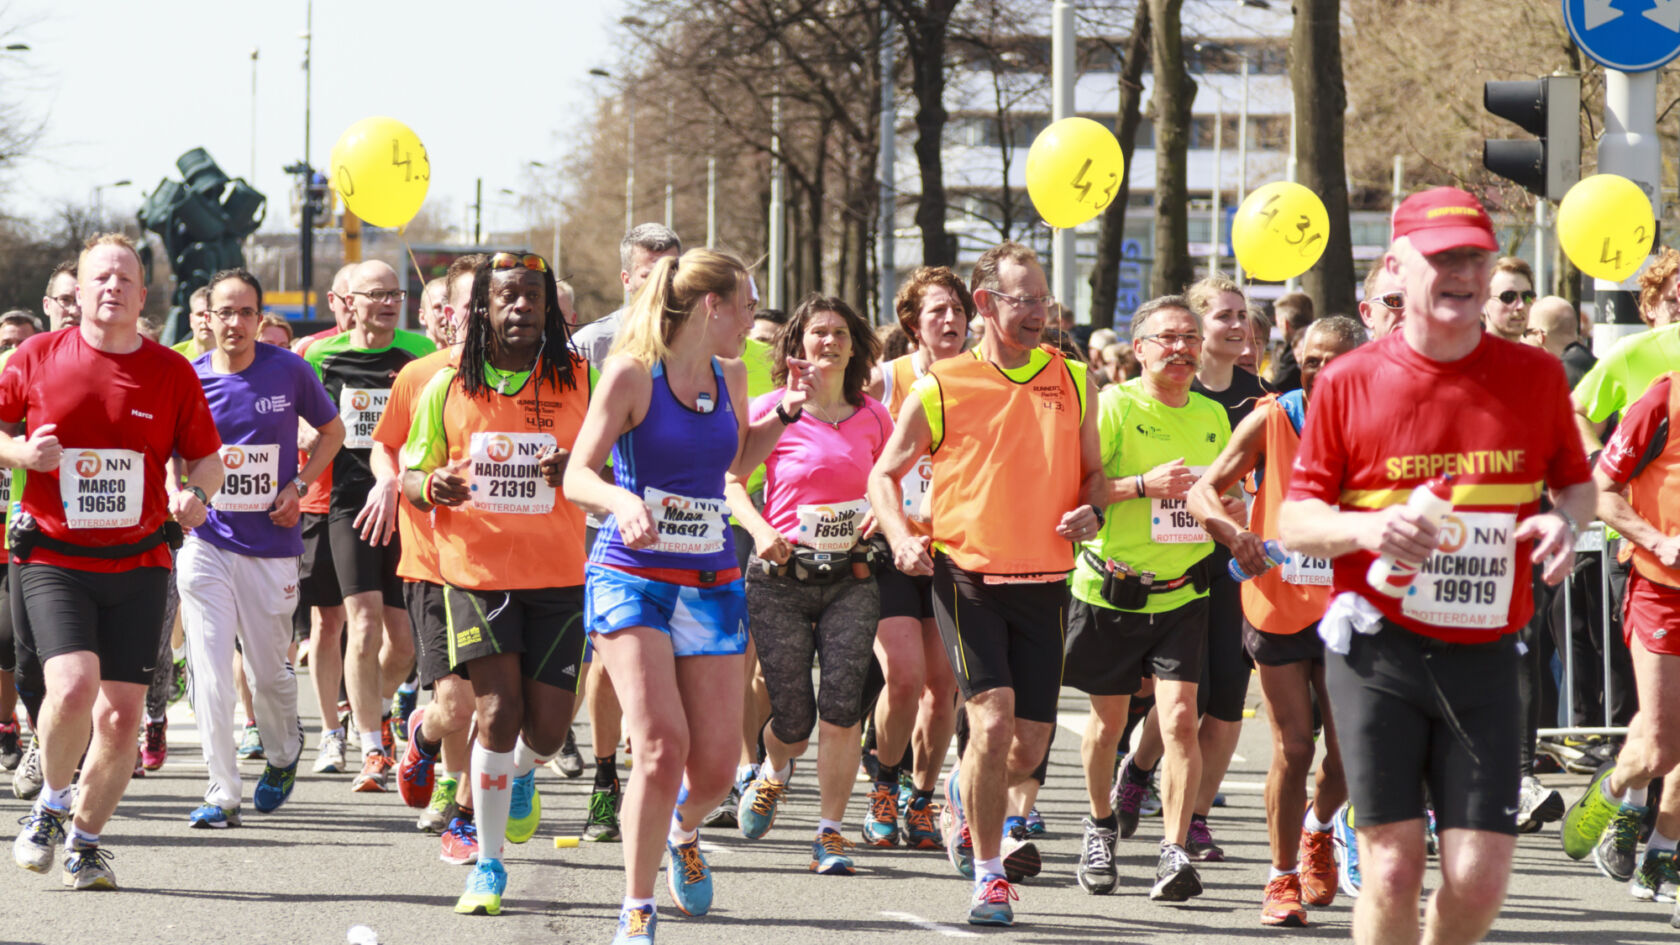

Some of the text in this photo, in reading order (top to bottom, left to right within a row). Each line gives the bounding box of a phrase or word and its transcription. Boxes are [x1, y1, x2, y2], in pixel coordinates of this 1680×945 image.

[131, 409, 153, 420] Marco
[518, 443, 543, 456] NN
[106, 458, 131, 471] NN
[248, 452, 269, 463] NN
[475, 463, 544, 479] HAROLDIN
[1386, 450, 1525, 480] SERPENTINE
[79, 479, 126, 493] MARCO
[489, 480, 537, 499] 21319
[77, 495, 126, 513] 19658
[695, 501, 719, 513] NN
[69, 518, 118, 527] OTTERDAM
[1170, 510, 1199, 528] 165
[814, 520, 854, 538] F8569
[1474, 527, 1508, 545] NN
[1156, 533, 1203, 542] ROTTERDAM
[648, 541, 702, 553] OTTERDAM
[1421, 554, 1508, 577] NICHOLAS
[1287, 574, 1332, 584] ROTTERDA
[1433, 579, 1497, 606] 19919
